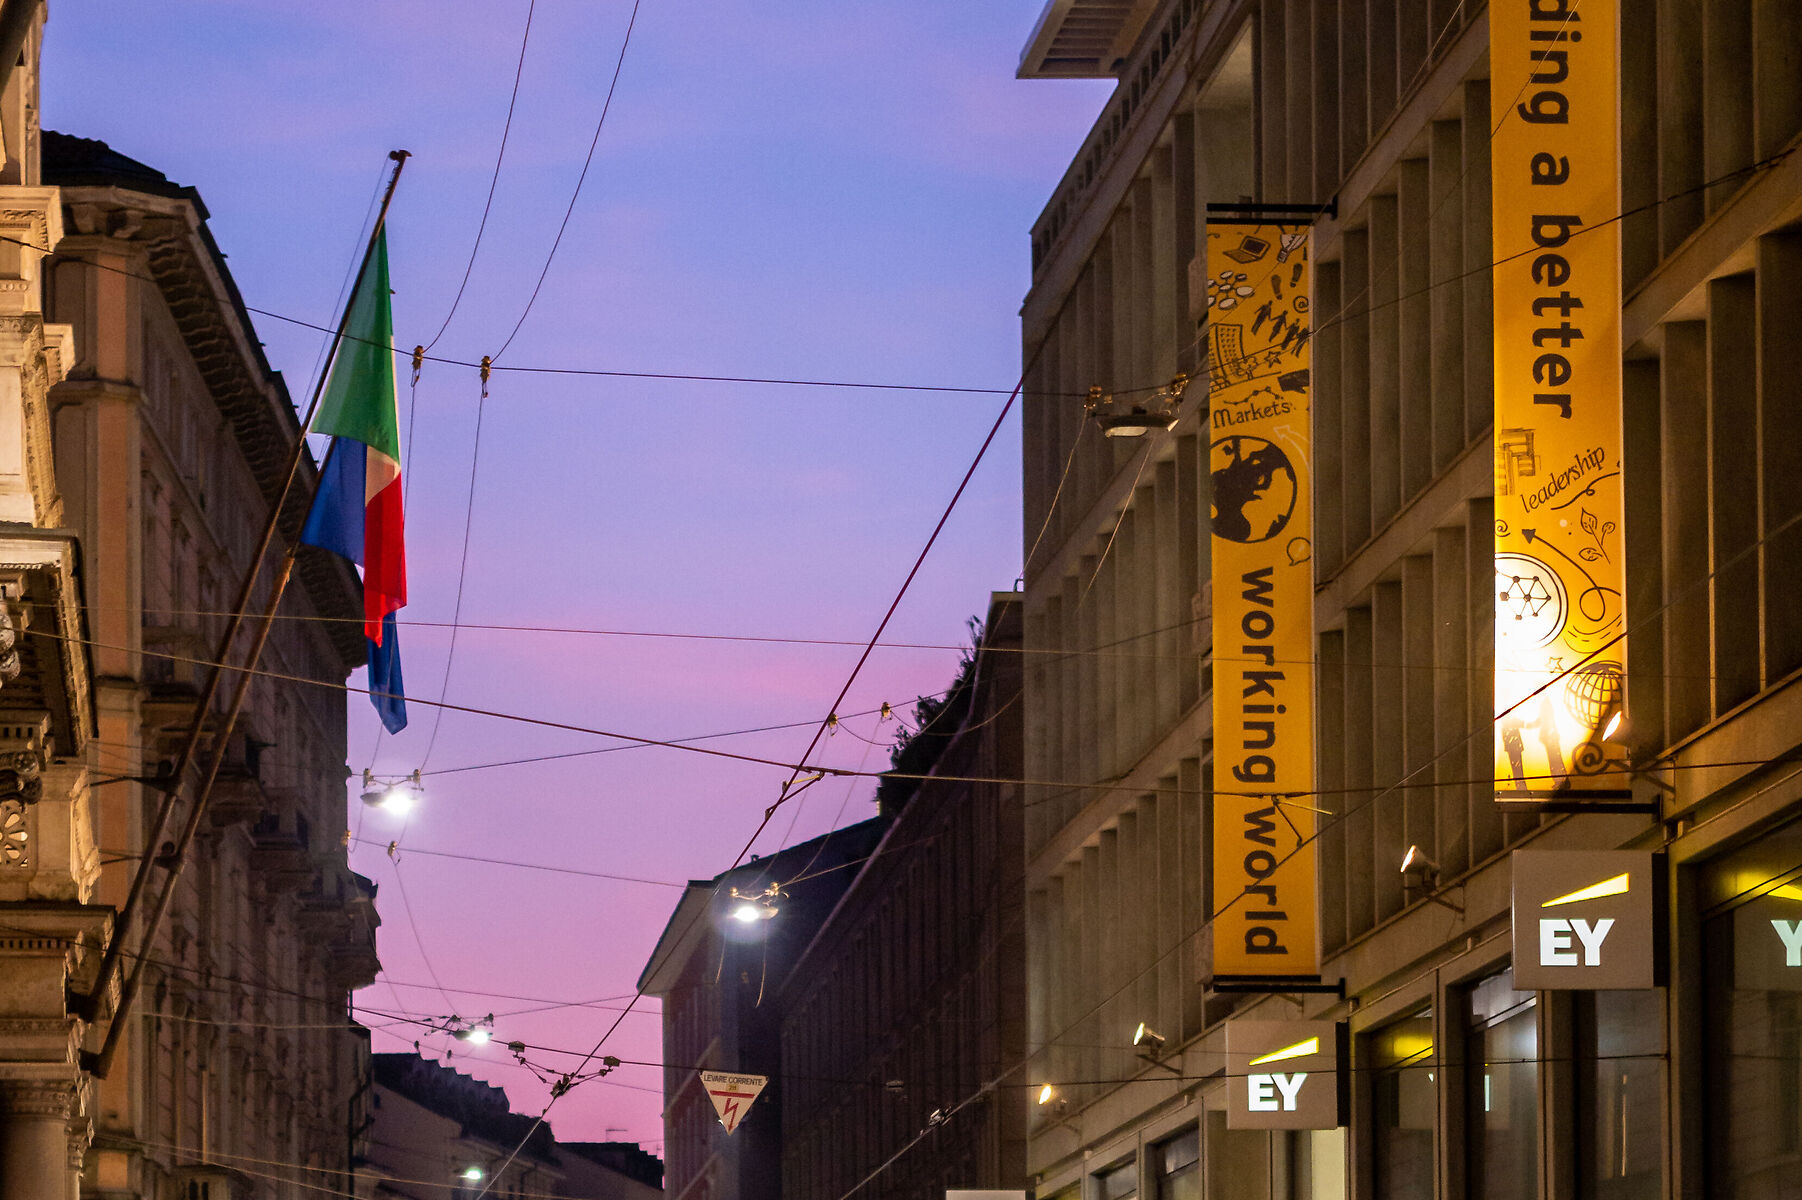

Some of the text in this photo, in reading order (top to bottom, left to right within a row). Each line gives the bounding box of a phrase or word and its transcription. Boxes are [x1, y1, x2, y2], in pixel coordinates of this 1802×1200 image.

[1531, 151, 1570, 186] a
[1531, 214, 1584, 419] better
[1213, 402, 1291, 429] Markets
[1520, 447, 1605, 513] leadership
[1232, 565, 1289, 956] working world
[1539, 918, 1616, 968] EY
[704, 1075, 763, 1086] LEVARE CORRENTE
[1247, 1072, 1308, 1112] EY
